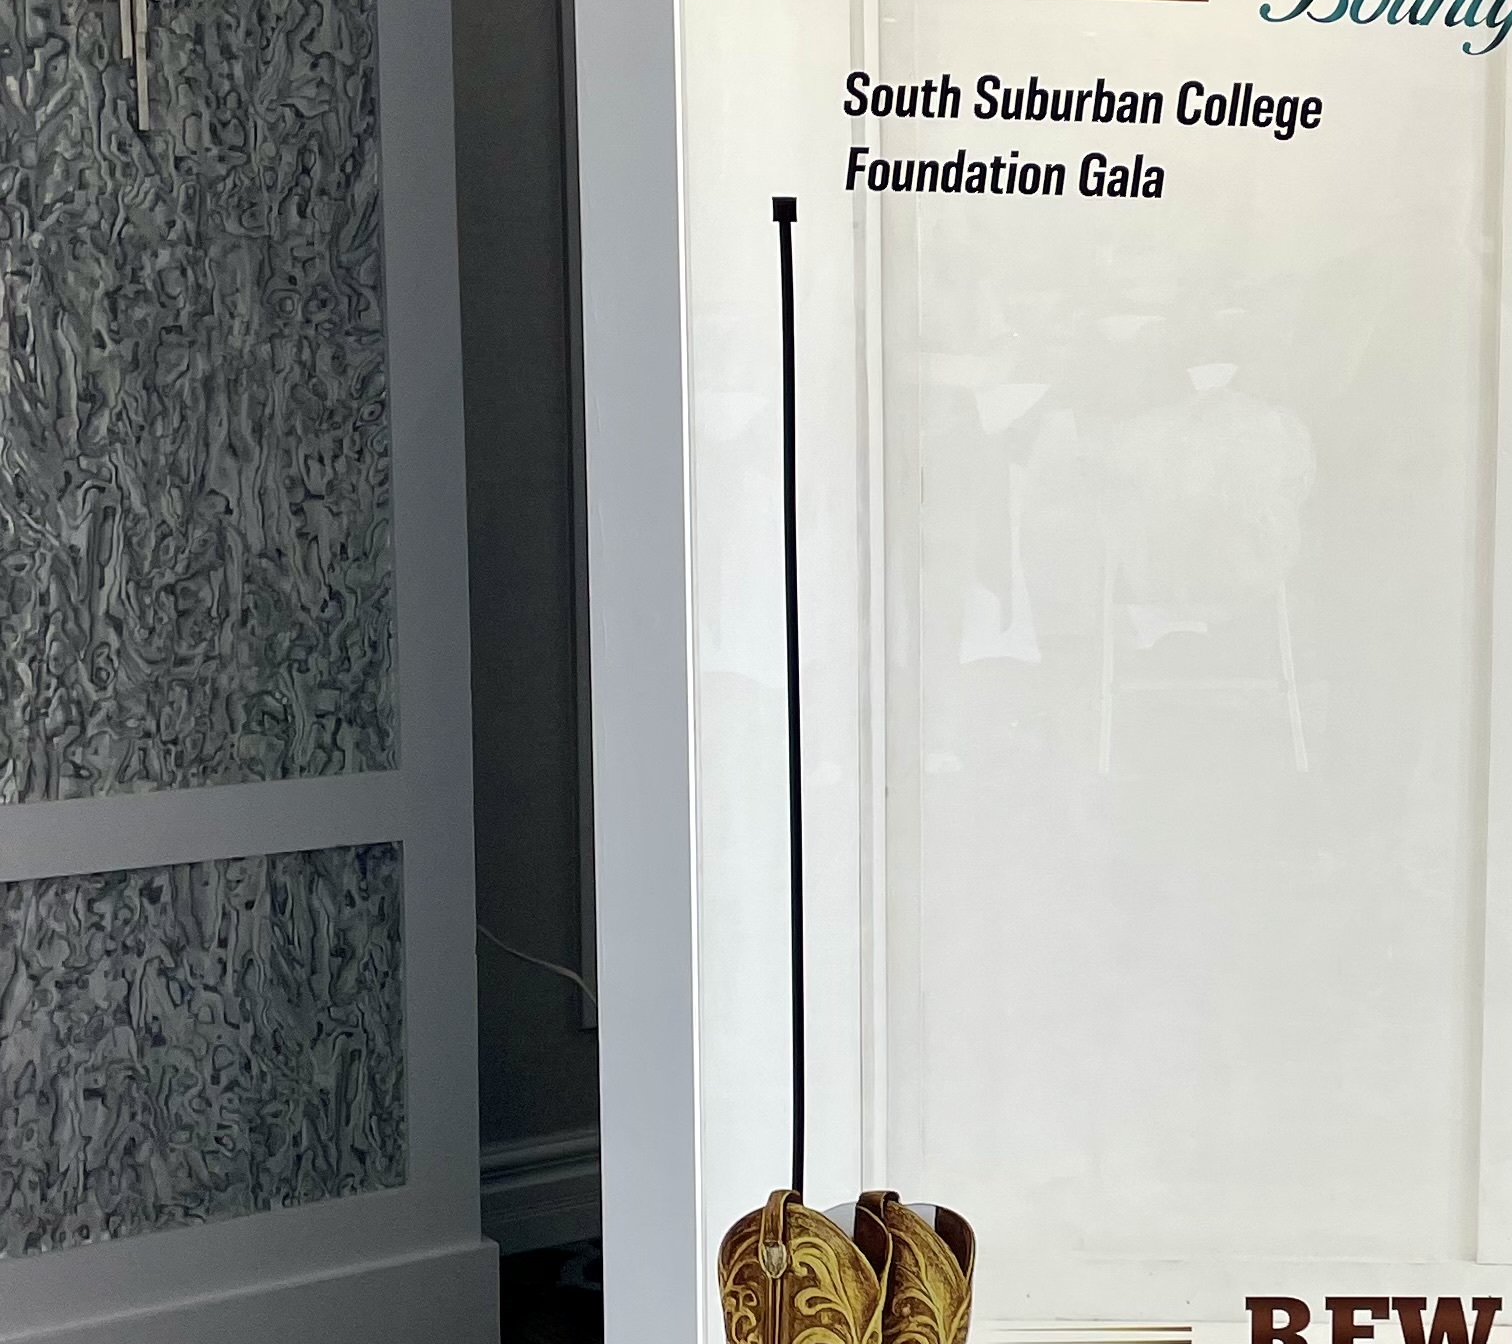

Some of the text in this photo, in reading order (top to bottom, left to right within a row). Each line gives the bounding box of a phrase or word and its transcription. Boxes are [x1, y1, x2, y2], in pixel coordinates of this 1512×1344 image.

[843, 70, 1324, 141] South Suburban College
[845, 146, 1166, 199] Foundation Gala
